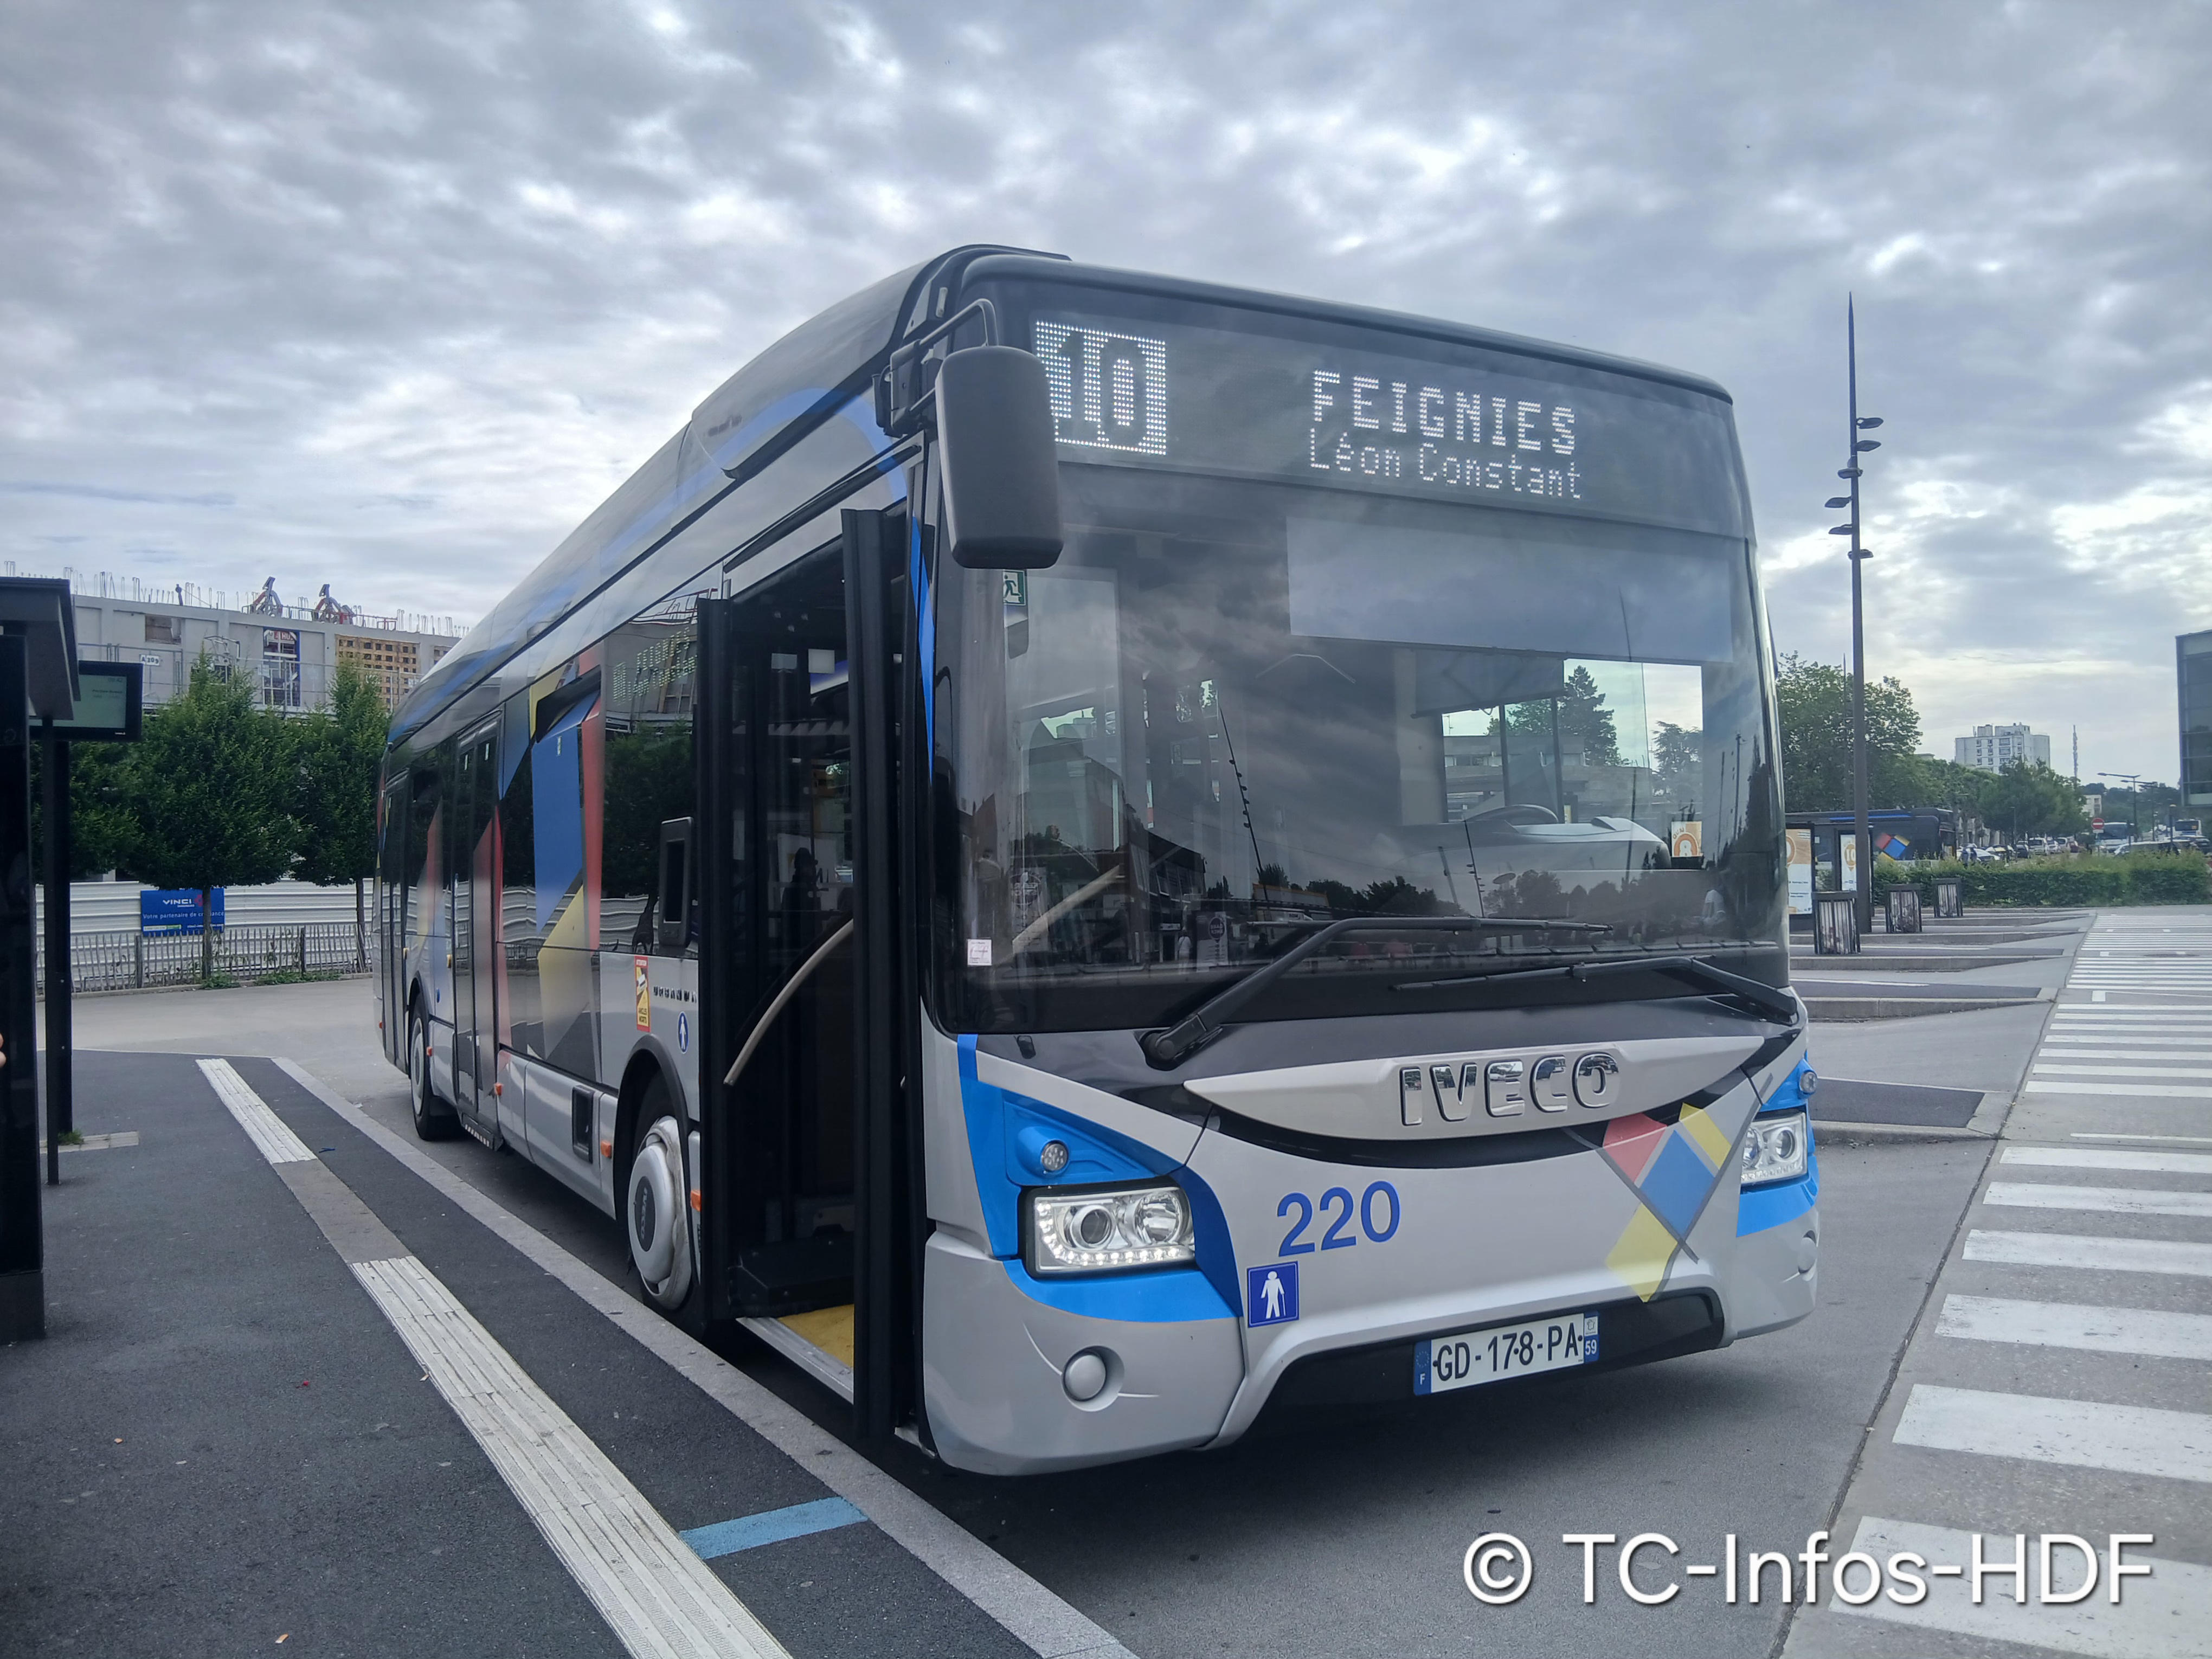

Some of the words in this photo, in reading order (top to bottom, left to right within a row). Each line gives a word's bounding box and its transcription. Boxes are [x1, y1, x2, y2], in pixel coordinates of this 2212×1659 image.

[1053, 327, 1150, 451] 10
[1313, 370, 1576, 455] FEIGNIES
[1310, 428, 1401, 478] Léon
[1419, 443, 1581, 500] Constant
[160, 912, 188, 920] partenaire
[1399, 1052, 1619, 1127] IVECO
[1277, 1180, 1400, 1257] 220
[1420, 1373, 1426, 1385] F
[1437, 1322, 1579, 1381] GD-178-PA
[1585, 1339, 1597, 1355] 59
